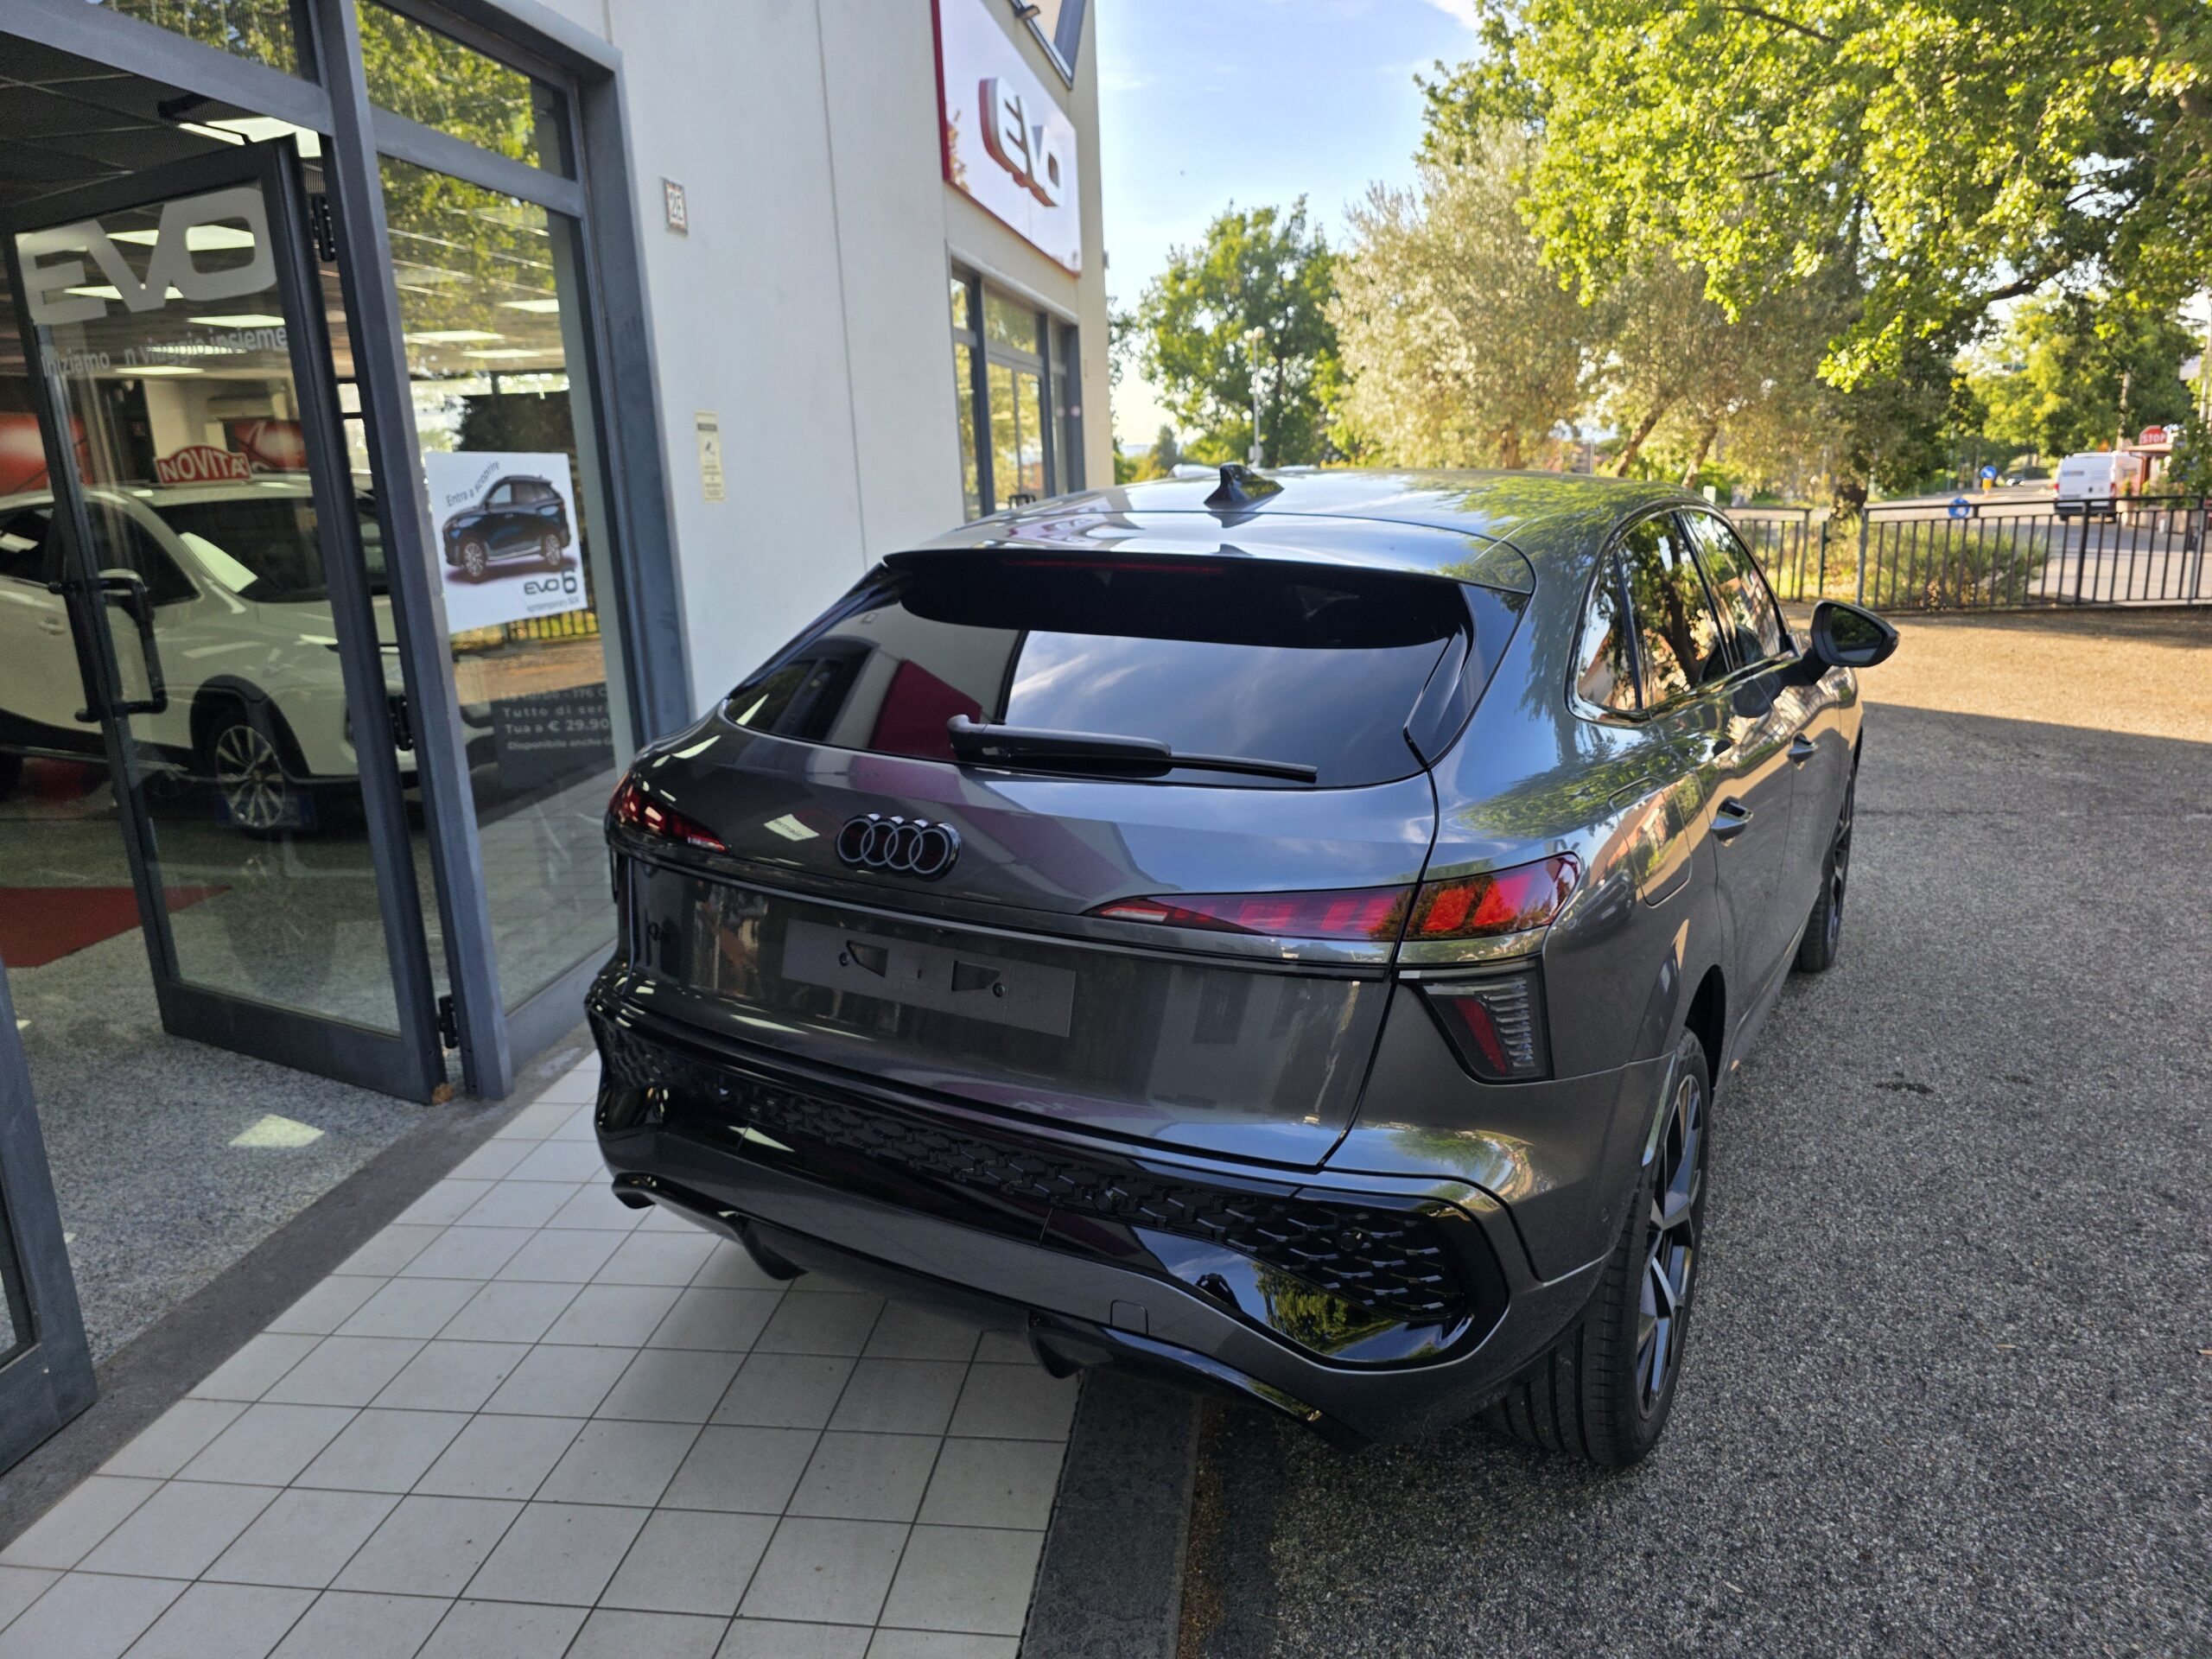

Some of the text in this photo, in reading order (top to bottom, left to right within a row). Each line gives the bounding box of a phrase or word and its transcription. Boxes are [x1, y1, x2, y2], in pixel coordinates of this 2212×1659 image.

[978, 76, 1064, 207] EVO
[15, 187, 277, 326] EVO
[209, 325, 288, 358] insieme
[2143, 433, 2166, 443] STOP
[446, 461, 500, 507] Entra a scoprire
[503, 707, 549, 718] Tutto
[578, 704, 608, 715] ser
[505, 723, 532, 734] Tua
